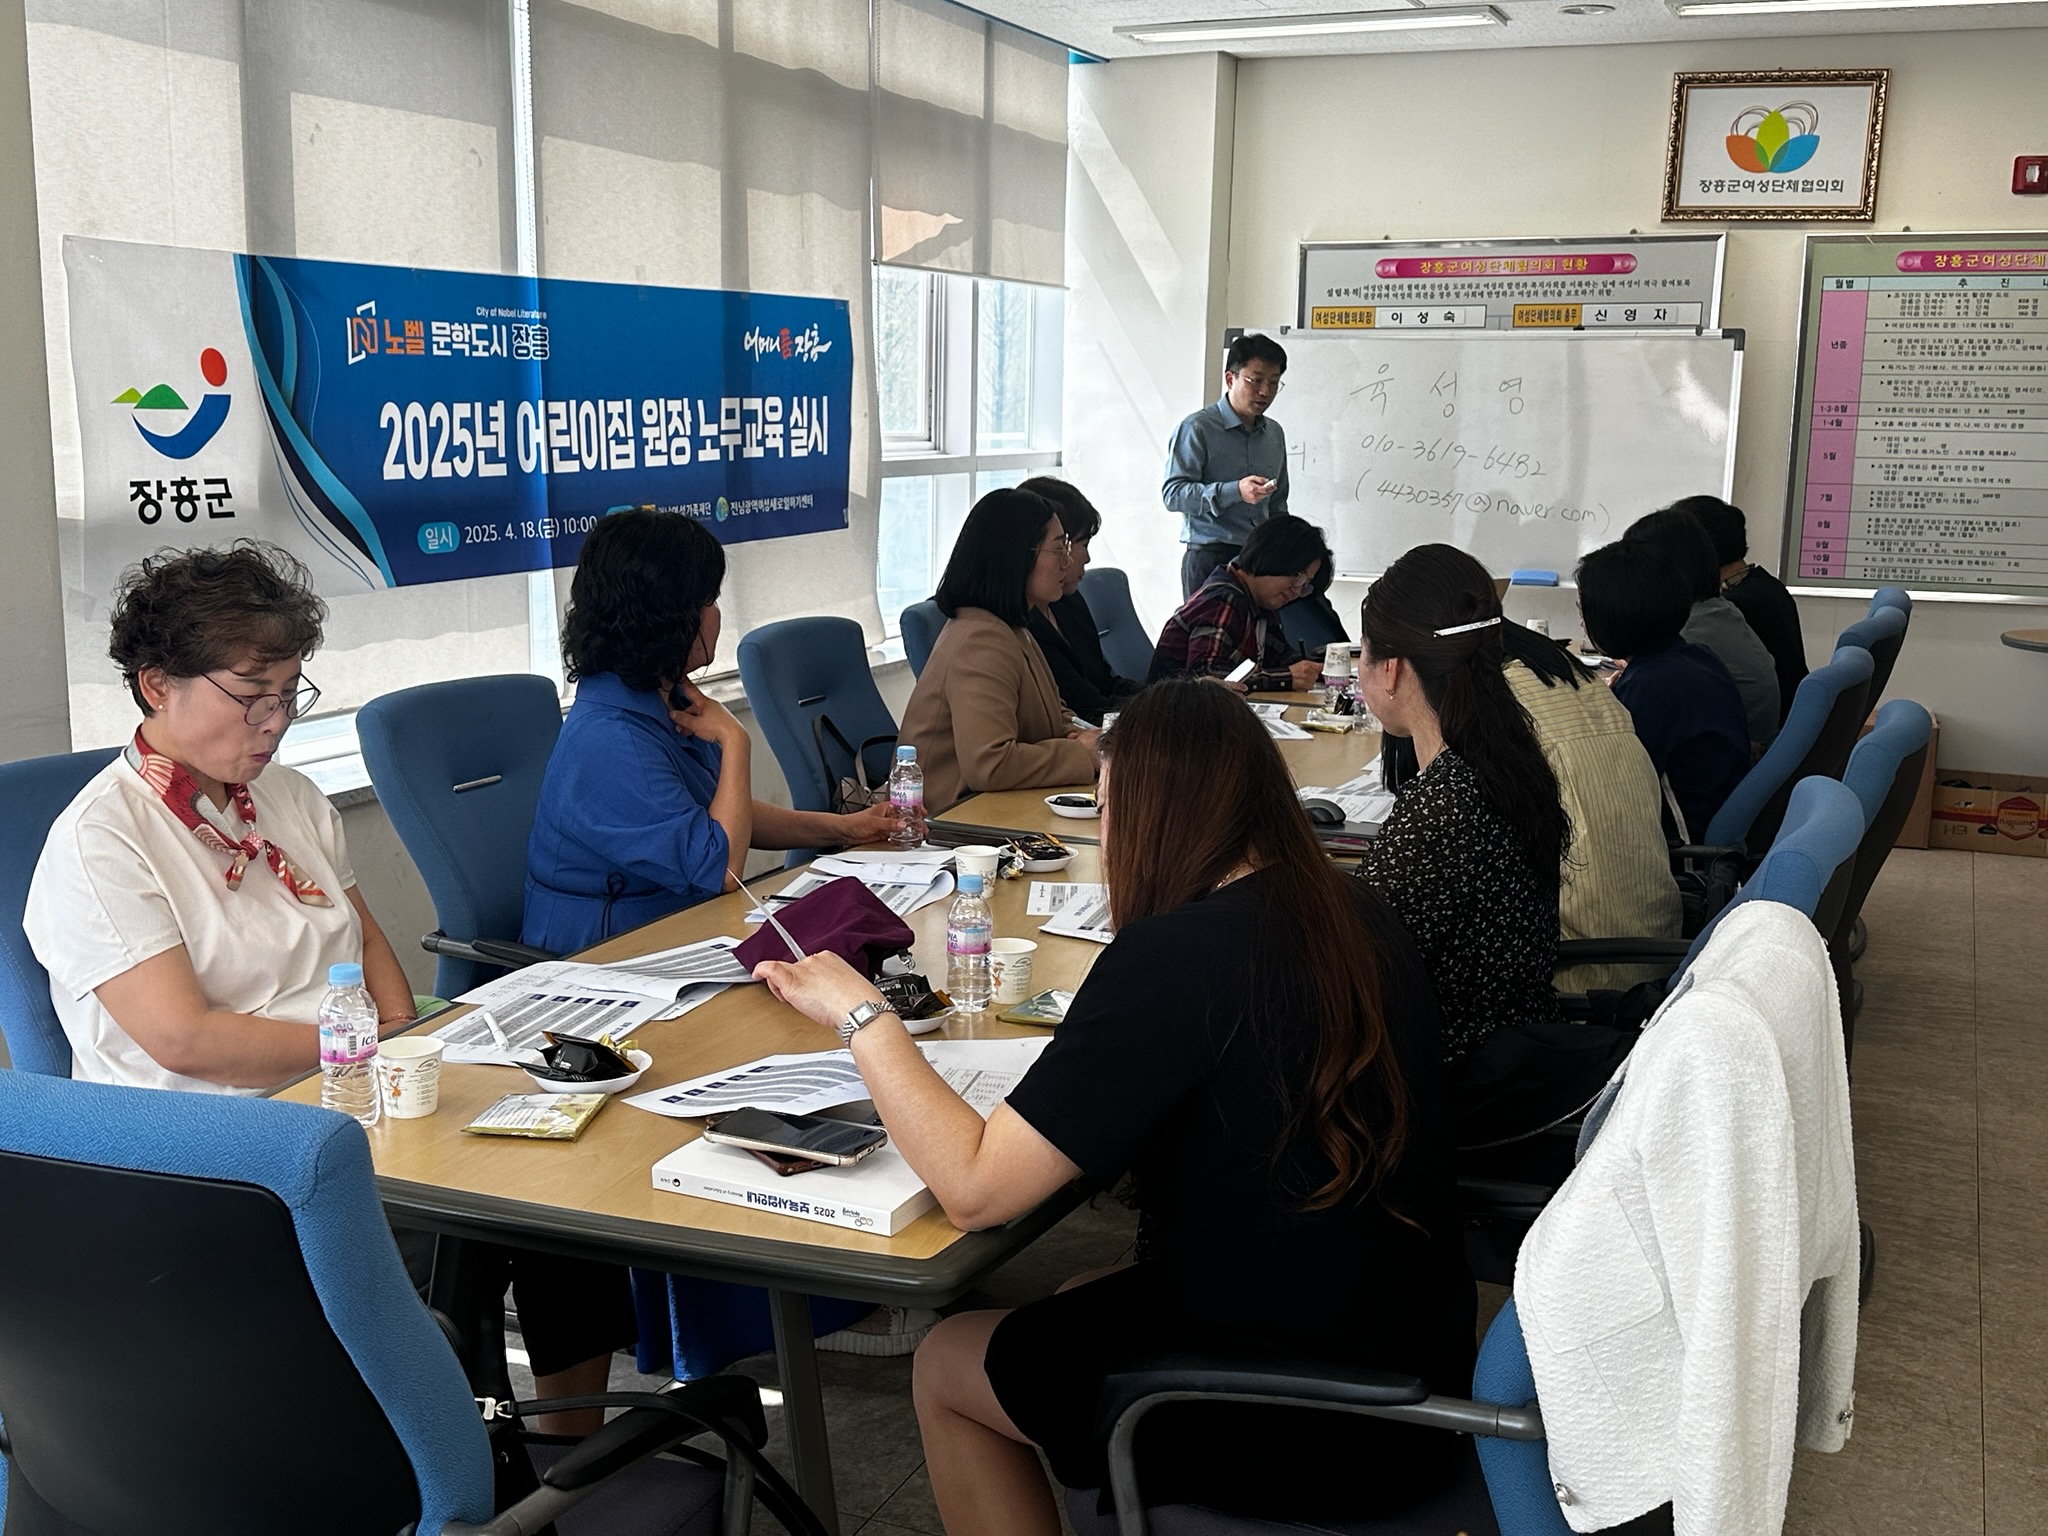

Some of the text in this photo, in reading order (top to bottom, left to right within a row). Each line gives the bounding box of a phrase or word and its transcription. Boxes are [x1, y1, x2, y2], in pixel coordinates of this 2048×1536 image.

[1699, 178, 1844, 194] 장흥군여성단체협의회
[1420, 257, 1589, 274] 장흥군여성단체협의회 현황
[1834, 278, 1855, 289] 월별
[476, 306, 548, 320] City of Nobel Literature
[1315, 310, 1372, 325] 여성단체협의회장
[1517, 308, 1562, 323] 여성단체협의회
[384, 319, 550, 360] 노벨 문학도시 장흥
[380, 395, 829, 481] 2025년 어린이집 원장 노무교육 실시
[129, 476, 236, 525] 장흥군
[1819, 493, 1833, 502] 7월
[425, 526, 453, 550] 일시
[464, 524, 501, 543] 2025.
[505, 522, 518, 540] 4.
[520, 517, 560, 539] 18.(금)
[746, 1190, 836, 1219] 2025 보육사업안내
